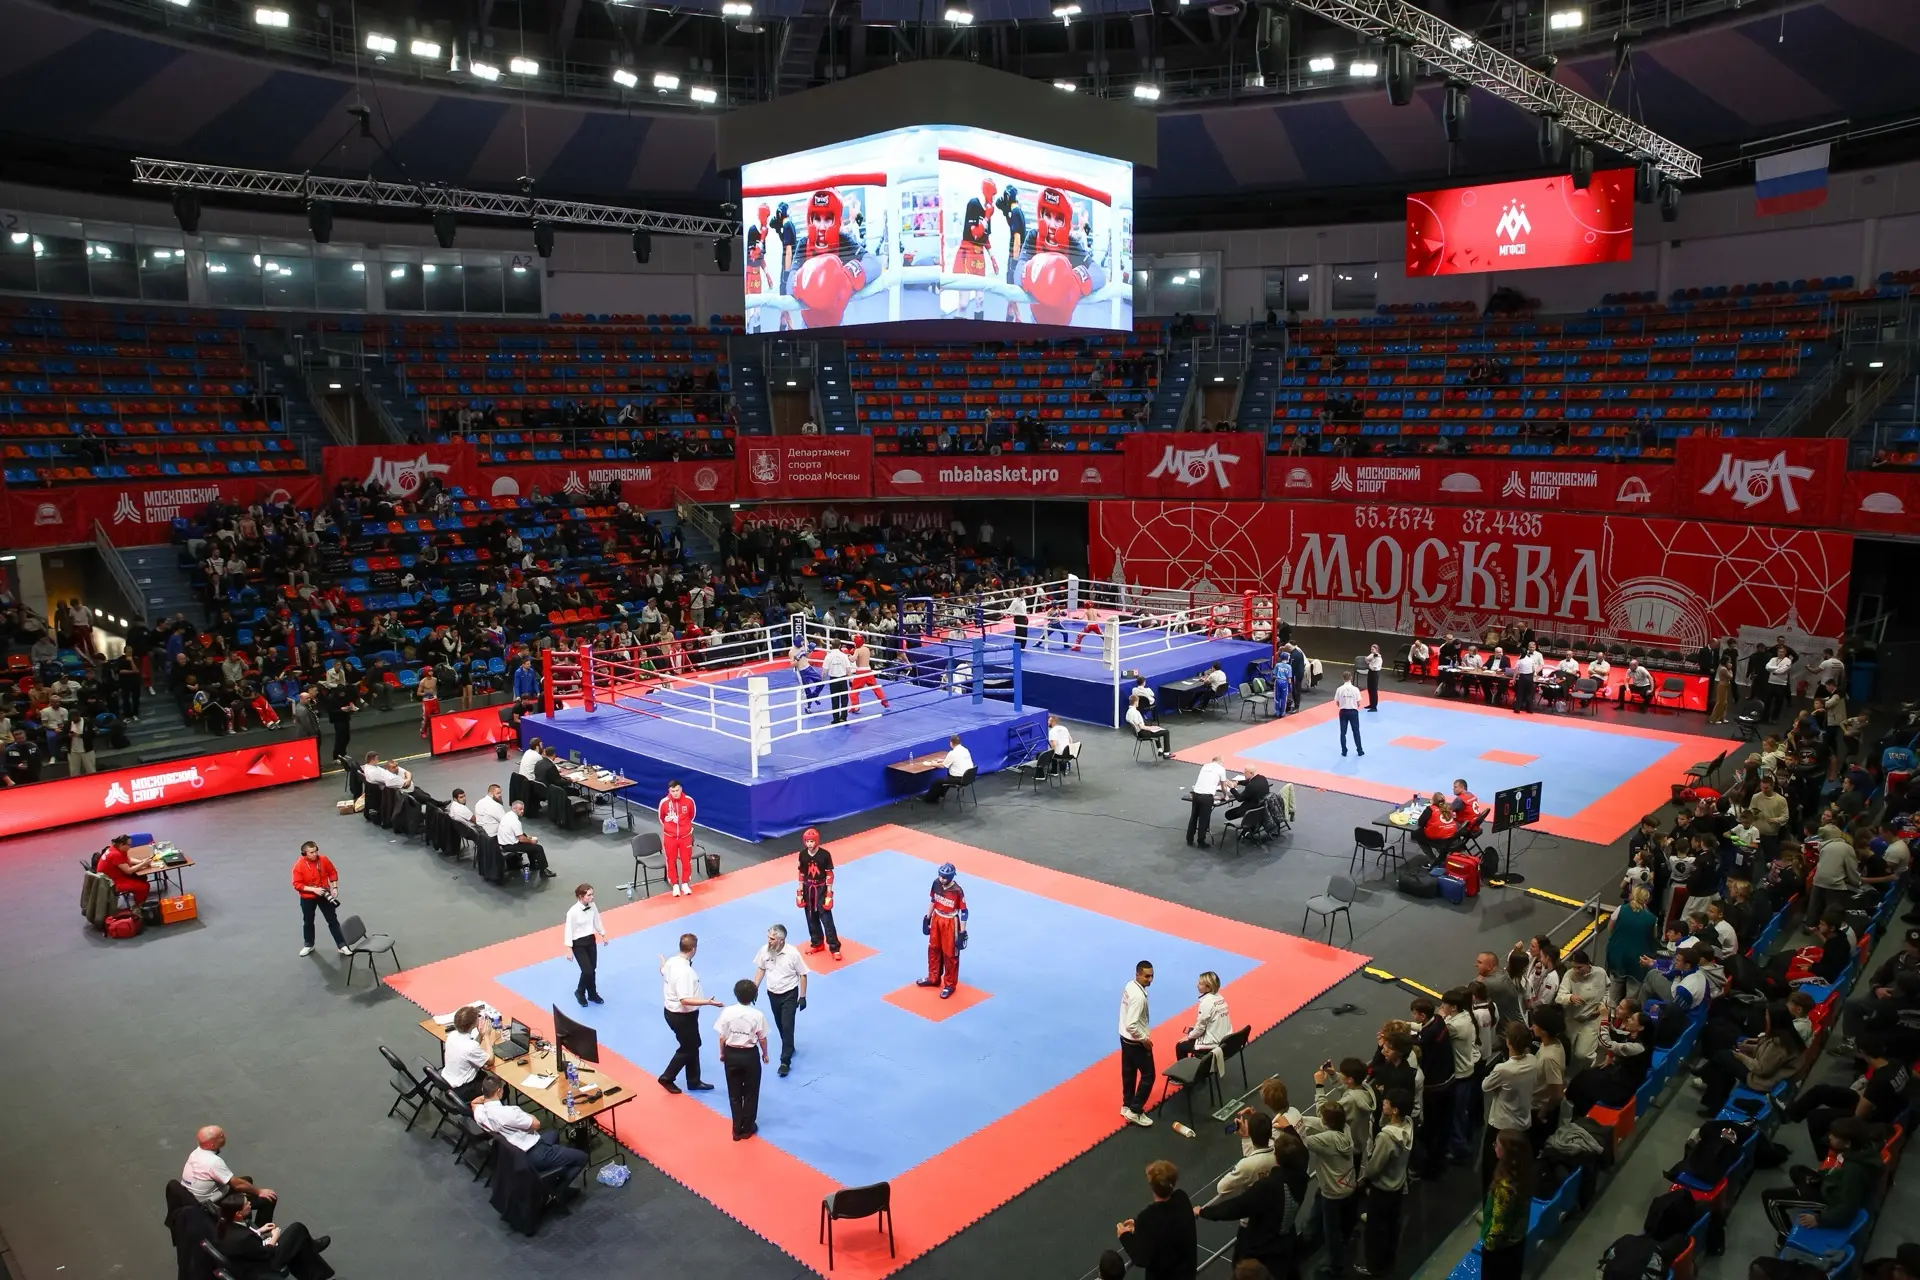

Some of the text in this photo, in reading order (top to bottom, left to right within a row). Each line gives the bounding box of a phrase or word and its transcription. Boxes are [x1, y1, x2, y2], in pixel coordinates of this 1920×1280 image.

[0, 214, 18, 230] 2
[788, 448, 851, 458] Департамент
[588, 465, 652, 482] МОСКОВСКИЙ
[788, 461, 822, 470] спорта
[1356, 465, 1421, 481] МОСКОВСКИЙ
[788, 471, 860, 482] города Москвы
[939, 465, 1059, 486] mbabasket.pro
[1530, 470, 1598, 488] МОСКОВСКИЙ
[1356, 480, 1387, 493] СПОРТ
[1529, 485, 1561, 500] СПОРТ
[143, 484, 220, 507] МОСКОВСКИЙ
[145, 505, 180, 523] СПОРТ
[1286, 533, 1605, 623] МОСКВА
[130, 767, 198, 792] МОСКОВСКИЙ
[132, 786, 164, 803] СПОРТ
